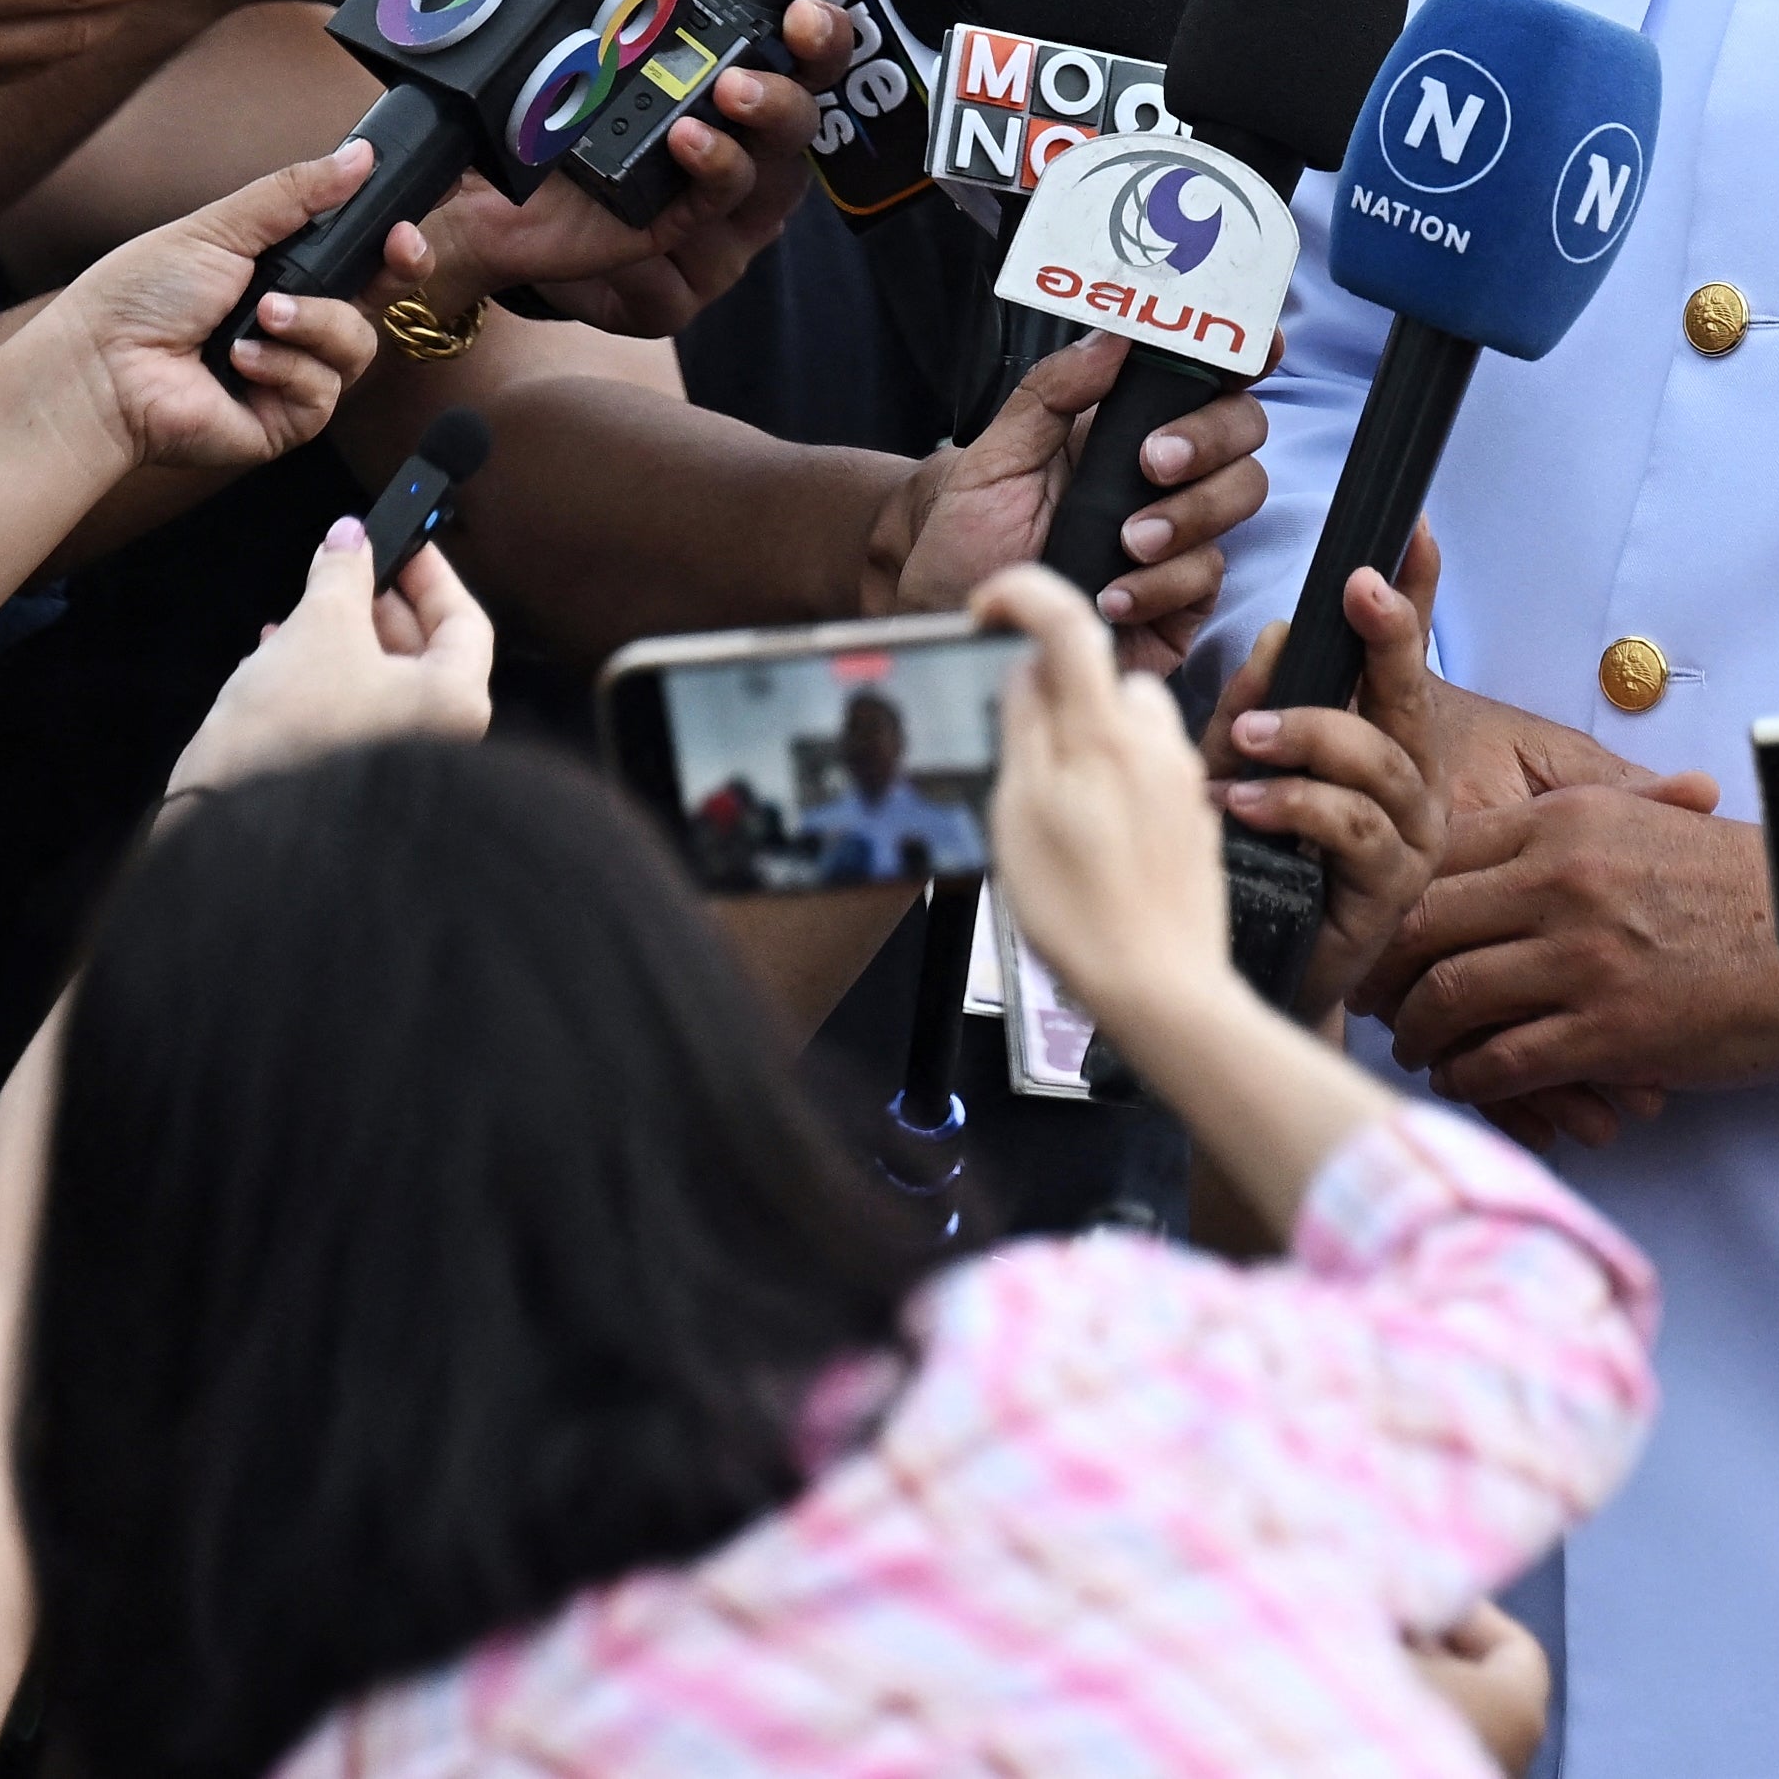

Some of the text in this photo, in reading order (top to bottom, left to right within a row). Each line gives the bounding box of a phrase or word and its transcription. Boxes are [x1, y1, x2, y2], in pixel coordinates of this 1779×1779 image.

[1403, 75, 1485, 164] N
[1351, 184, 1471, 254] NATION
[1573, 152, 1631, 233] N
